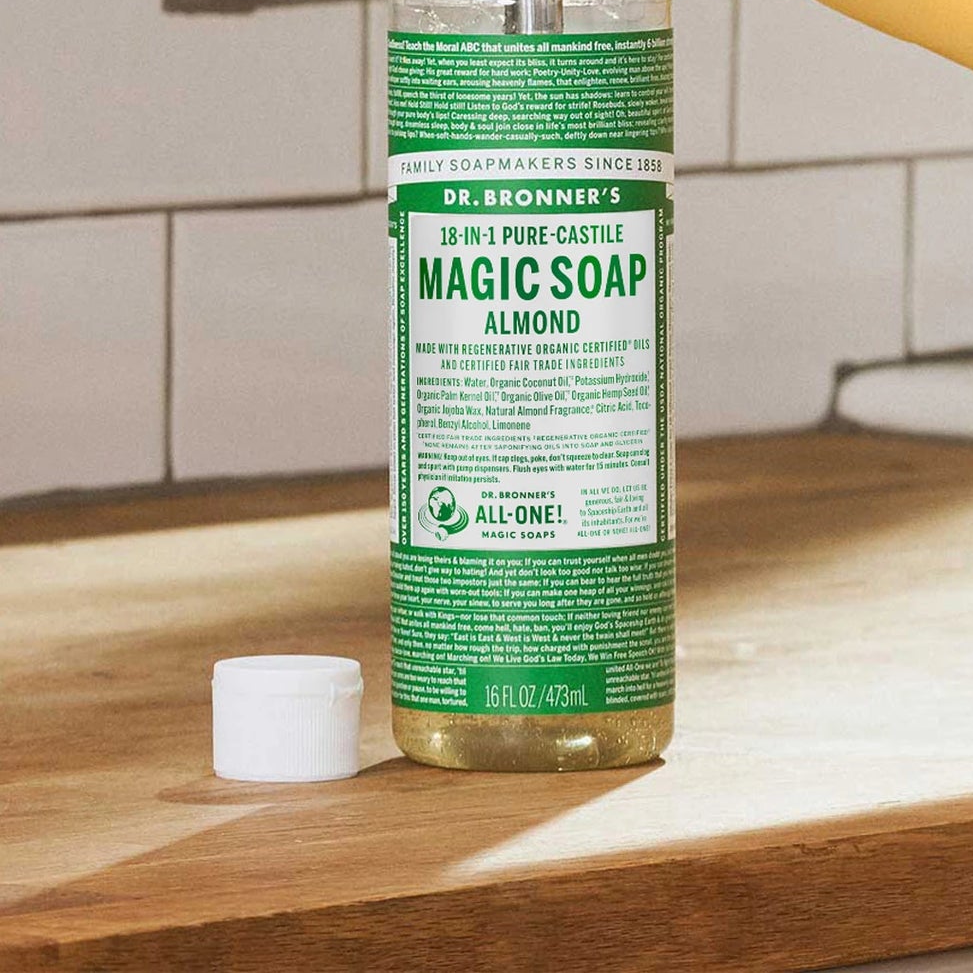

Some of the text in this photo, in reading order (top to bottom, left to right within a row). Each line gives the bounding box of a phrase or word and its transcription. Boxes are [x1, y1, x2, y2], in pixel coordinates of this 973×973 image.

[423, 41, 434, 51] the
[435, 41, 459, 52] Moral
[460, 42, 480, 52] ABC
[481, 42, 502, 52] that
[503, 42, 535, 52] unites
[537, 42, 549, 52] all
[551, 41, 593, 52] mankind
[594, 40, 614, 52] free,
[615, 39, 646, 51] instantly
[489, 60, 514, 68] expect
[578, 58, 603, 66] around
[456, 92, 491, 100] lonesome
[451, 112, 487, 121] Caressing
[488, 112, 510, 121] deep,
[512, 112, 551, 121] searching
[594, 111, 614, 120] sight!
[401, 157, 662, 175] FAMILY SOAPMAKERS SINCE 1858
[444, 187, 621, 207] DR. BRONNER'S
[440, 224, 624, 246] 18-IN-1 PURE-CASTILE
[418, 253, 647, 301] MAGIC SOAP
[400, 316, 406, 333] OF
[484, 309, 581, 335] ALMOND
[415, 340, 436, 354] MADE
[438, 341, 459, 355] WITH
[462, 342, 533, 356] REGENERATIVE
[535, 341, 580, 355] ORGANIC
[633, 338, 650, 350] OILS
[441, 356, 625, 371] AND CERTIFIED FAIR TRADE INGREDIENTS
[416, 376, 463, 387] INGREDIENTS:
[464, 377, 488, 388] Water,
[490, 377, 521, 389] Organic
[522, 377, 557, 388] Coconut
[575, 374, 614, 386] Potassium
[416, 389, 440, 401] Organic
[441, 390, 457, 401] Palm
[460, 391, 483, 401] Kernel
[501, 391, 532, 404] Organic
[533, 391, 553, 401] Olive
[571, 389, 601, 403] Organic
[602, 388, 623, 400] Hemp
[623, 387, 639, 397] Seed
[416, 403, 440, 416] Organic
[442, 404, 464, 416] Jojoba
[466, 406, 483, 416] Wax,
[485, 406, 515, 416] Natural
[517, 405, 548, 416] Almond
[595, 403, 616, 414] Citric
[617, 401, 634, 412] Acid,
[438, 418, 460, 431] Benzyl
[492, 419, 531, 430] Limonene
[512, 464, 531, 473] Flush
[532, 465, 548, 473] eyes
[549, 464, 565, 472] with
[481, 490, 556, 499] DR. BRONNER'S
[482, 531, 556, 539] MAGIC SOAPS
[532, 559, 546, 567] you
[583, 556, 611, 566] yourself
[523, 601, 537, 609] you
[539, 599, 556, 608] long
[577, 598, 592, 607] they
[478, 633, 494, 641] East
[531, 633, 550, 641] West
[582, 632, 594, 640] the
[506, 654, 521, 662] Live
[523, 654, 545, 663] God's
[547, 654, 562, 662] Law
[563, 653, 587, 662] Today.
[484, 685, 499, 708] 16
[502, 685, 517, 708] FL
